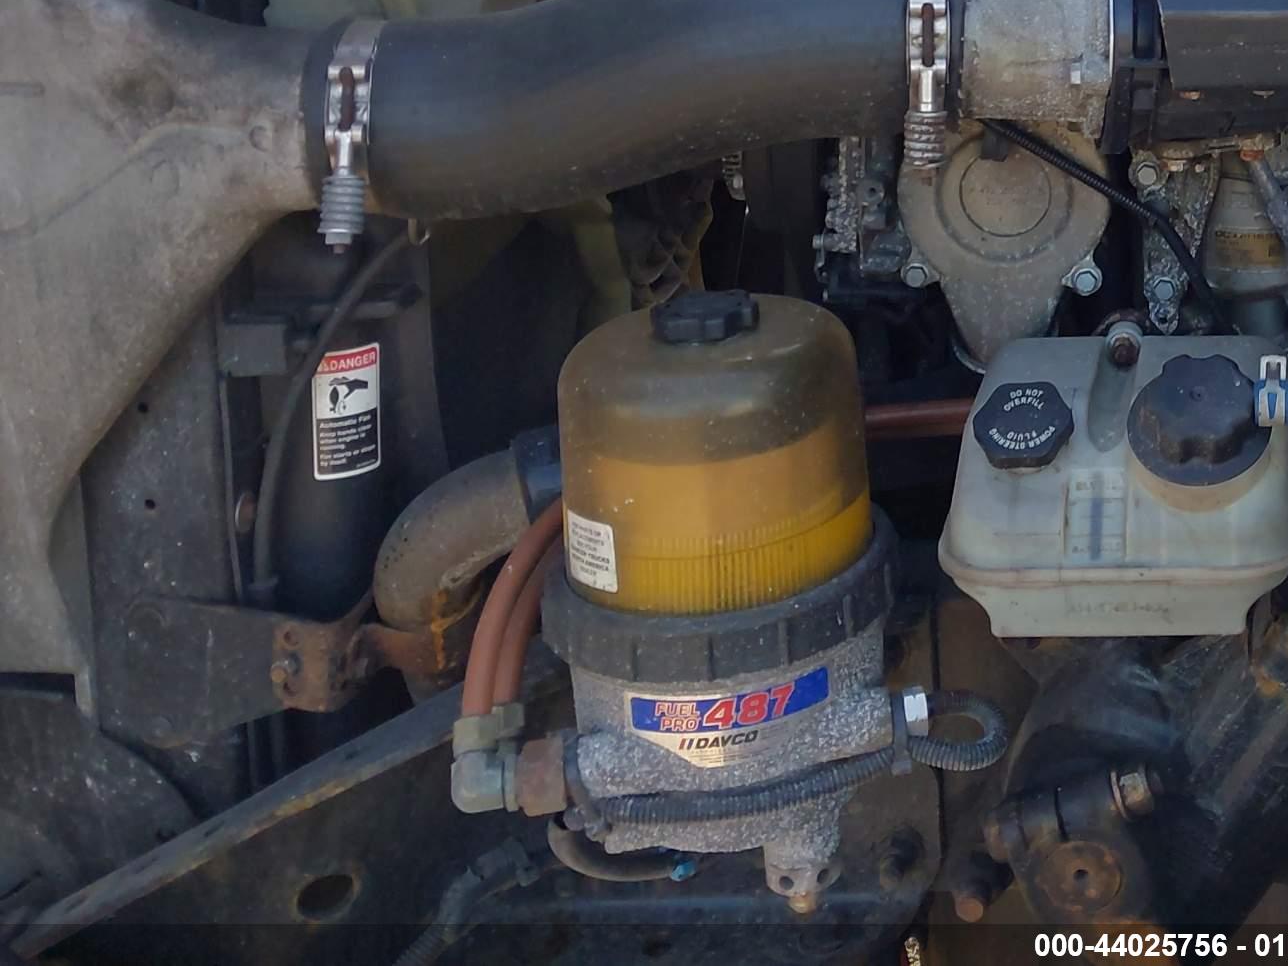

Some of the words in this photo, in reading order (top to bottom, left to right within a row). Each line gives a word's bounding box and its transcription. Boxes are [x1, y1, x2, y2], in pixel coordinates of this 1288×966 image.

[330, 351, 376, 371] DANGER
[1010, 389, 1023, 398] DO
[1025, 388, 1043, 397] NOT
[1003, 396, 1044, 411] OVERFILL
[988, 428, 1026, 450] STEERING
[1006, 430, 1037, 441] FLUID
[1028, 426, 1056, 448] POWER
[655, 702, 700, 717] FUEL
[702, 681, 795, 731] 487
[661, 717, 700, 732] PRO
[695, 730, 759, 750] DAVCO
